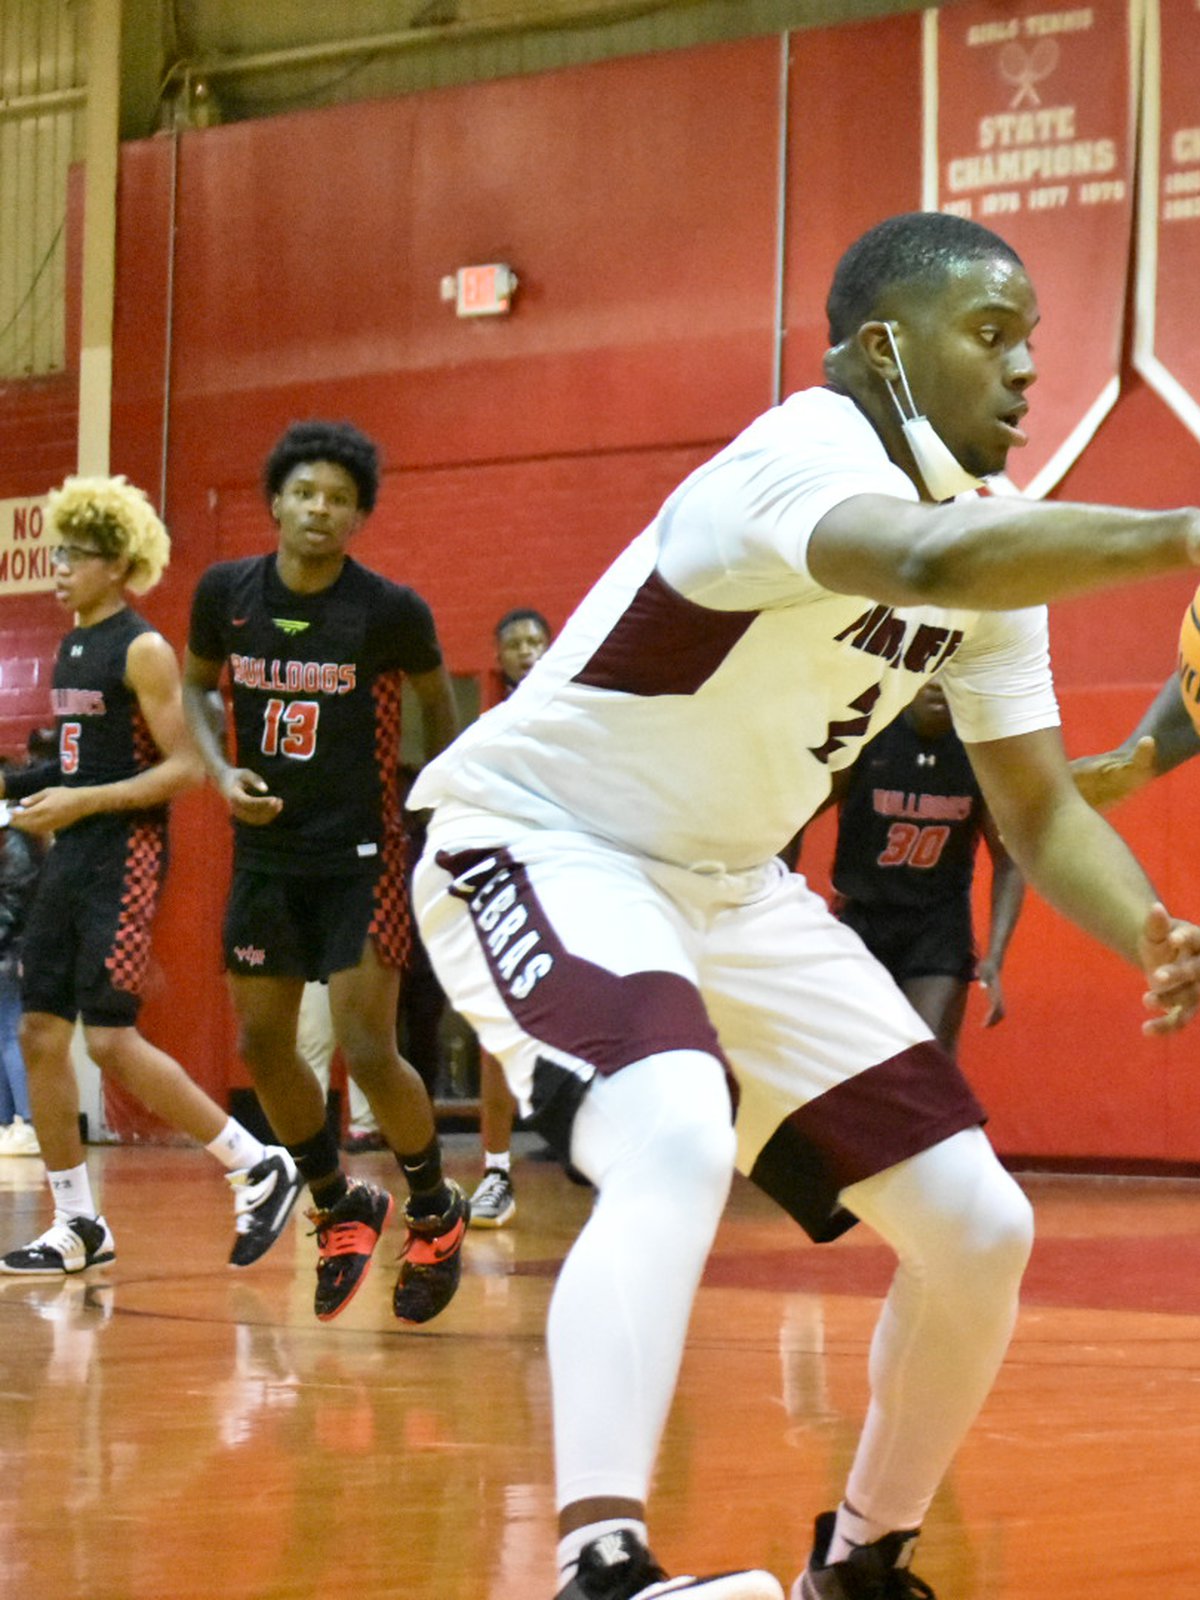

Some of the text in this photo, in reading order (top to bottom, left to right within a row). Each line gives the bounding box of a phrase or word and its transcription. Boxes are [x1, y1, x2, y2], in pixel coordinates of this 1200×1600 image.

[979, 106, 1076, 148] STATE
[948, 139, 1116, 191] CHAMPIONS
[13, 506, 43, 541] NO
[230, 653, 357, 695] BULLDOGS
[60, 722, 82, 774] 5
[261, 698, 320, 762] 13
[877, 822, 950, 869] 30
